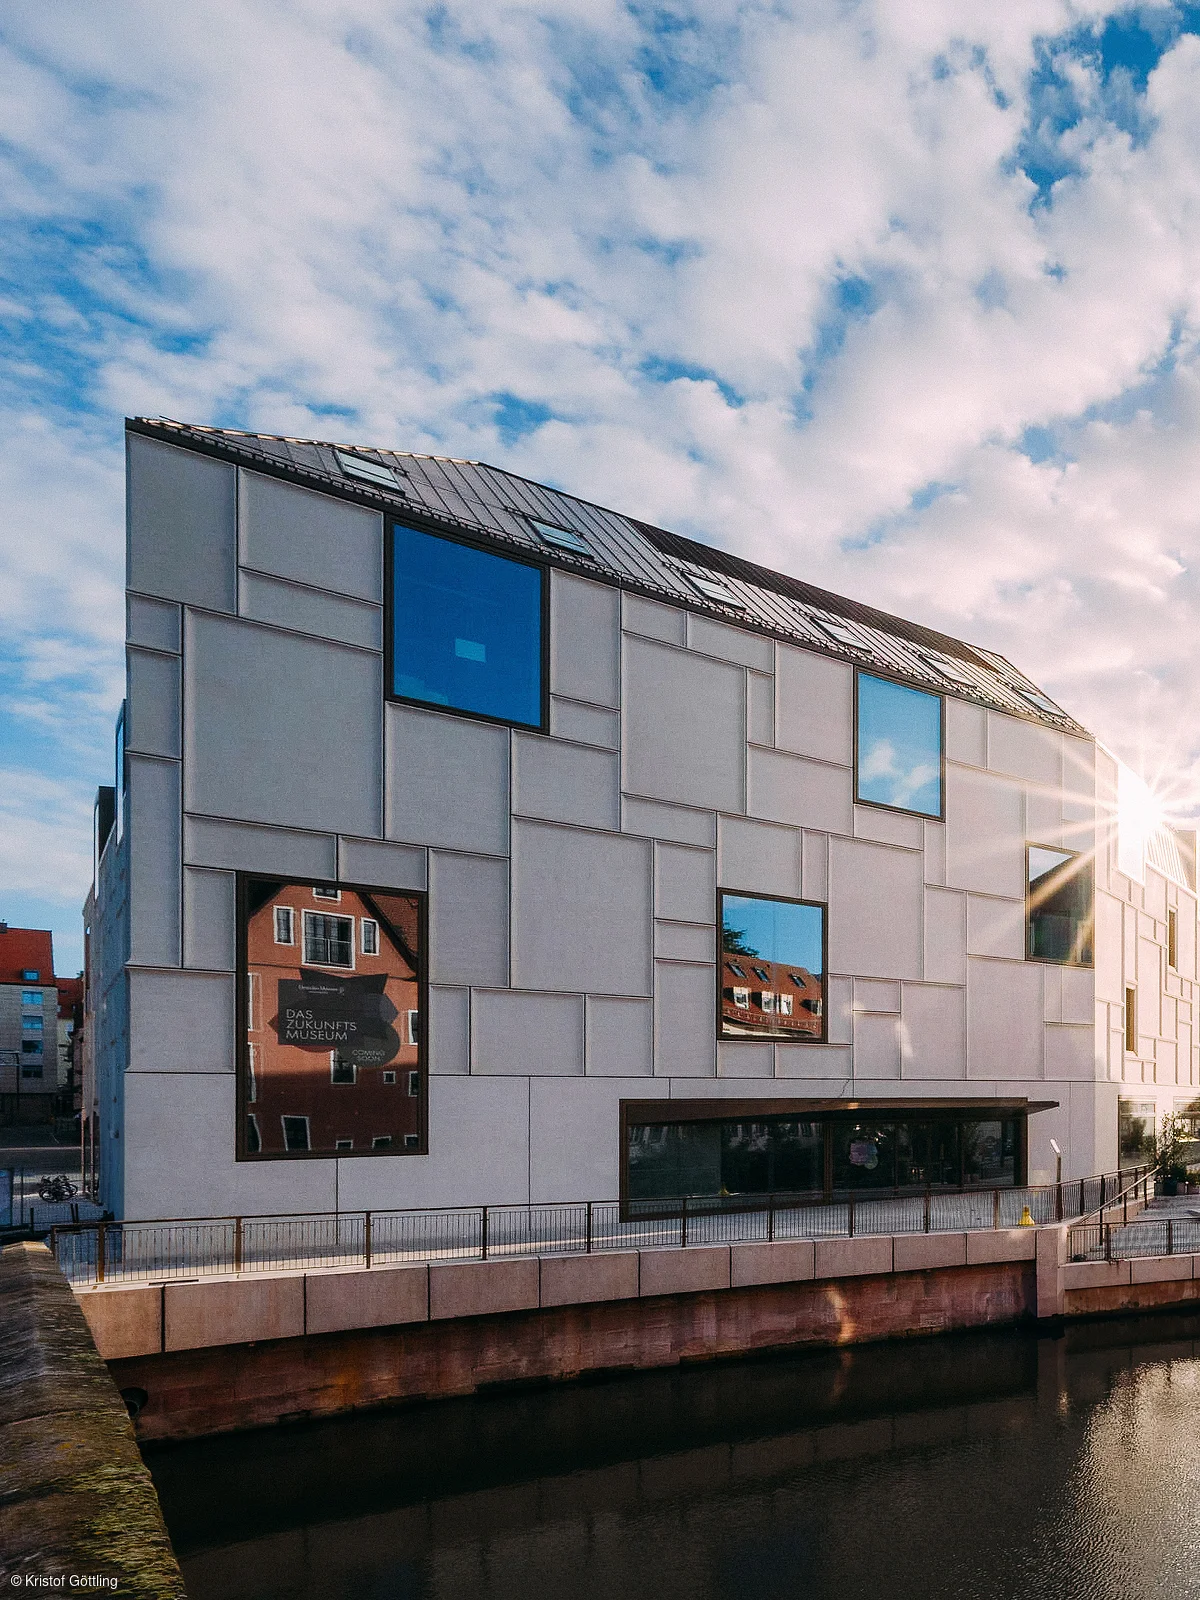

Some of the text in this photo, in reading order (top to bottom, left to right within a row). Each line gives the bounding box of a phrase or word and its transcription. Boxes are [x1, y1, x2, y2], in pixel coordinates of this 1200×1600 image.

[286, 1009, 313, 1019] DAS
[286, 1020, 357, 1031] ZUKUNFTS
[286, 1030, 348, 1040] MUSEUM
